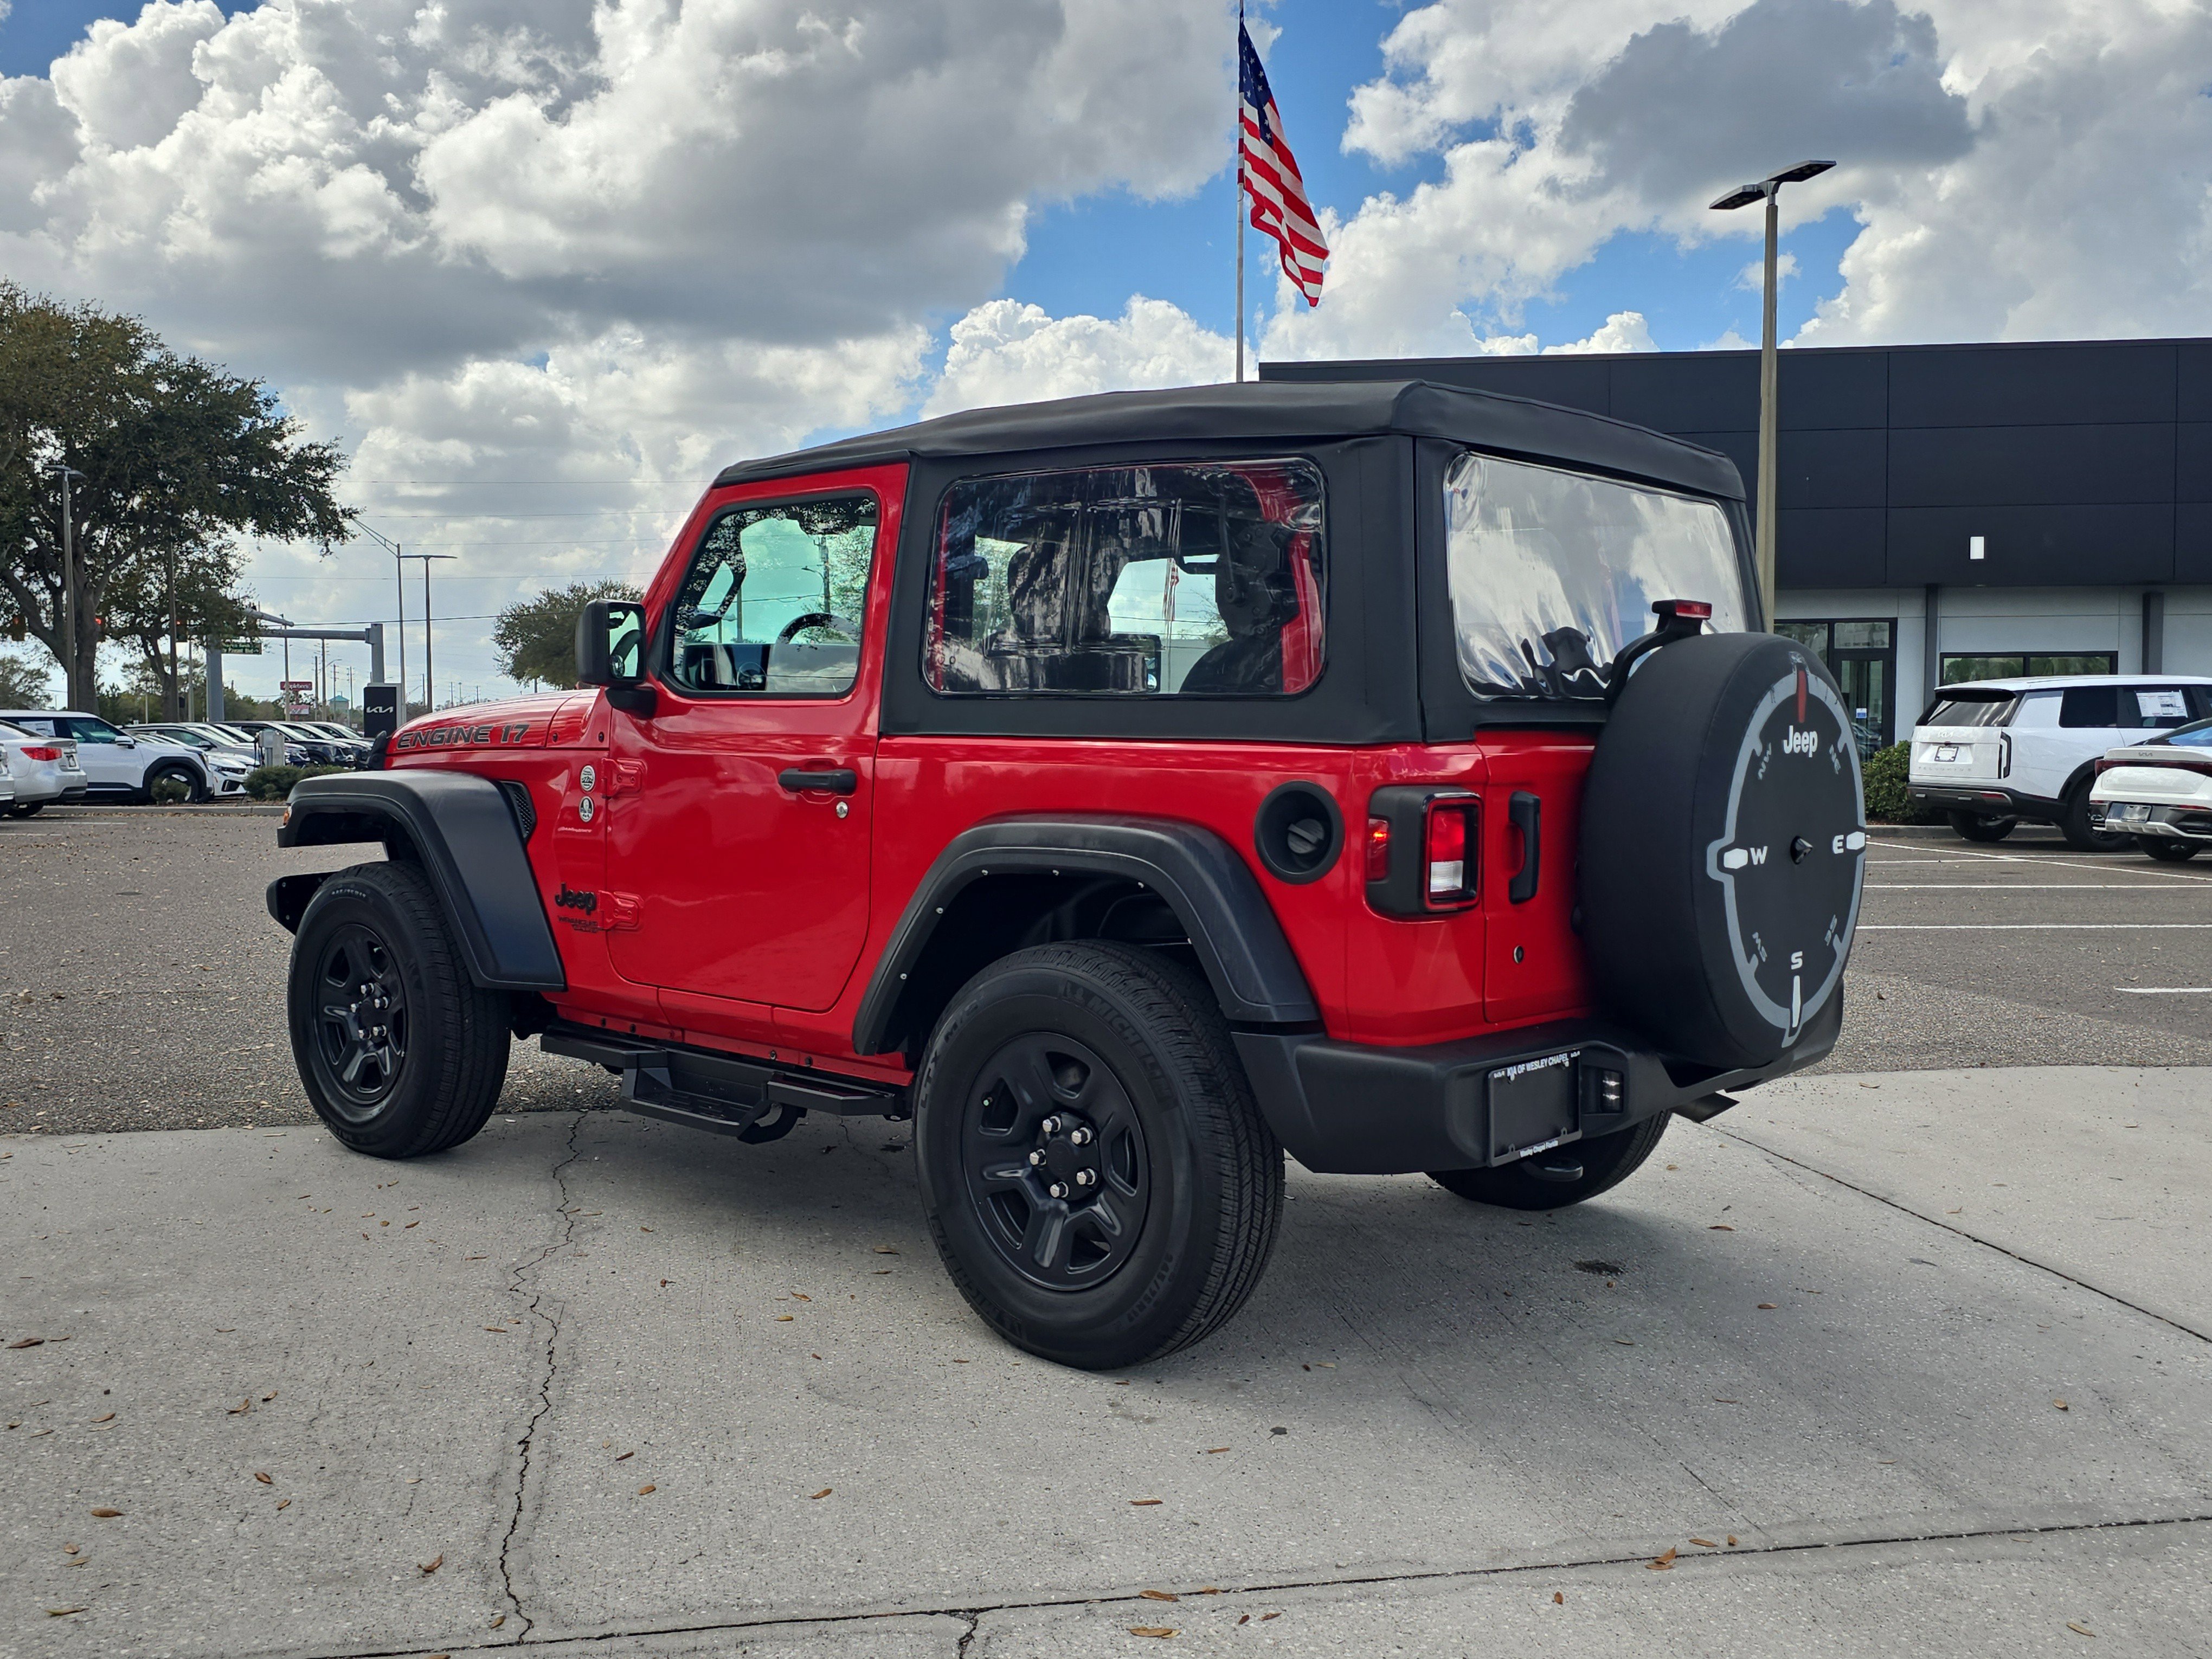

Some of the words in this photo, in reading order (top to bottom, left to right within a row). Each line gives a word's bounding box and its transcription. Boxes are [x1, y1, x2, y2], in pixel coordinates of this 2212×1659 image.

[396, 725, 494, 750] ENGINE
[500, 723, 530, 744] 17
[1783, 725, 1818, 758] Jeep
[1757, 742, 1772, 781] NW
[1829, 744, 1841, 775] NE
[1750, 846, 1768, 865] W
[1832, 834, 1844, 854] E
[555, 882, 597, 916] Jeep
[1790, 950, 1803, 970] S
[1518, 1064, 1526, 1074] OF
[1526, 1057, 1548, 1072] WESLEY
[1548, 1052, 1569, 1066] CHAPEL
